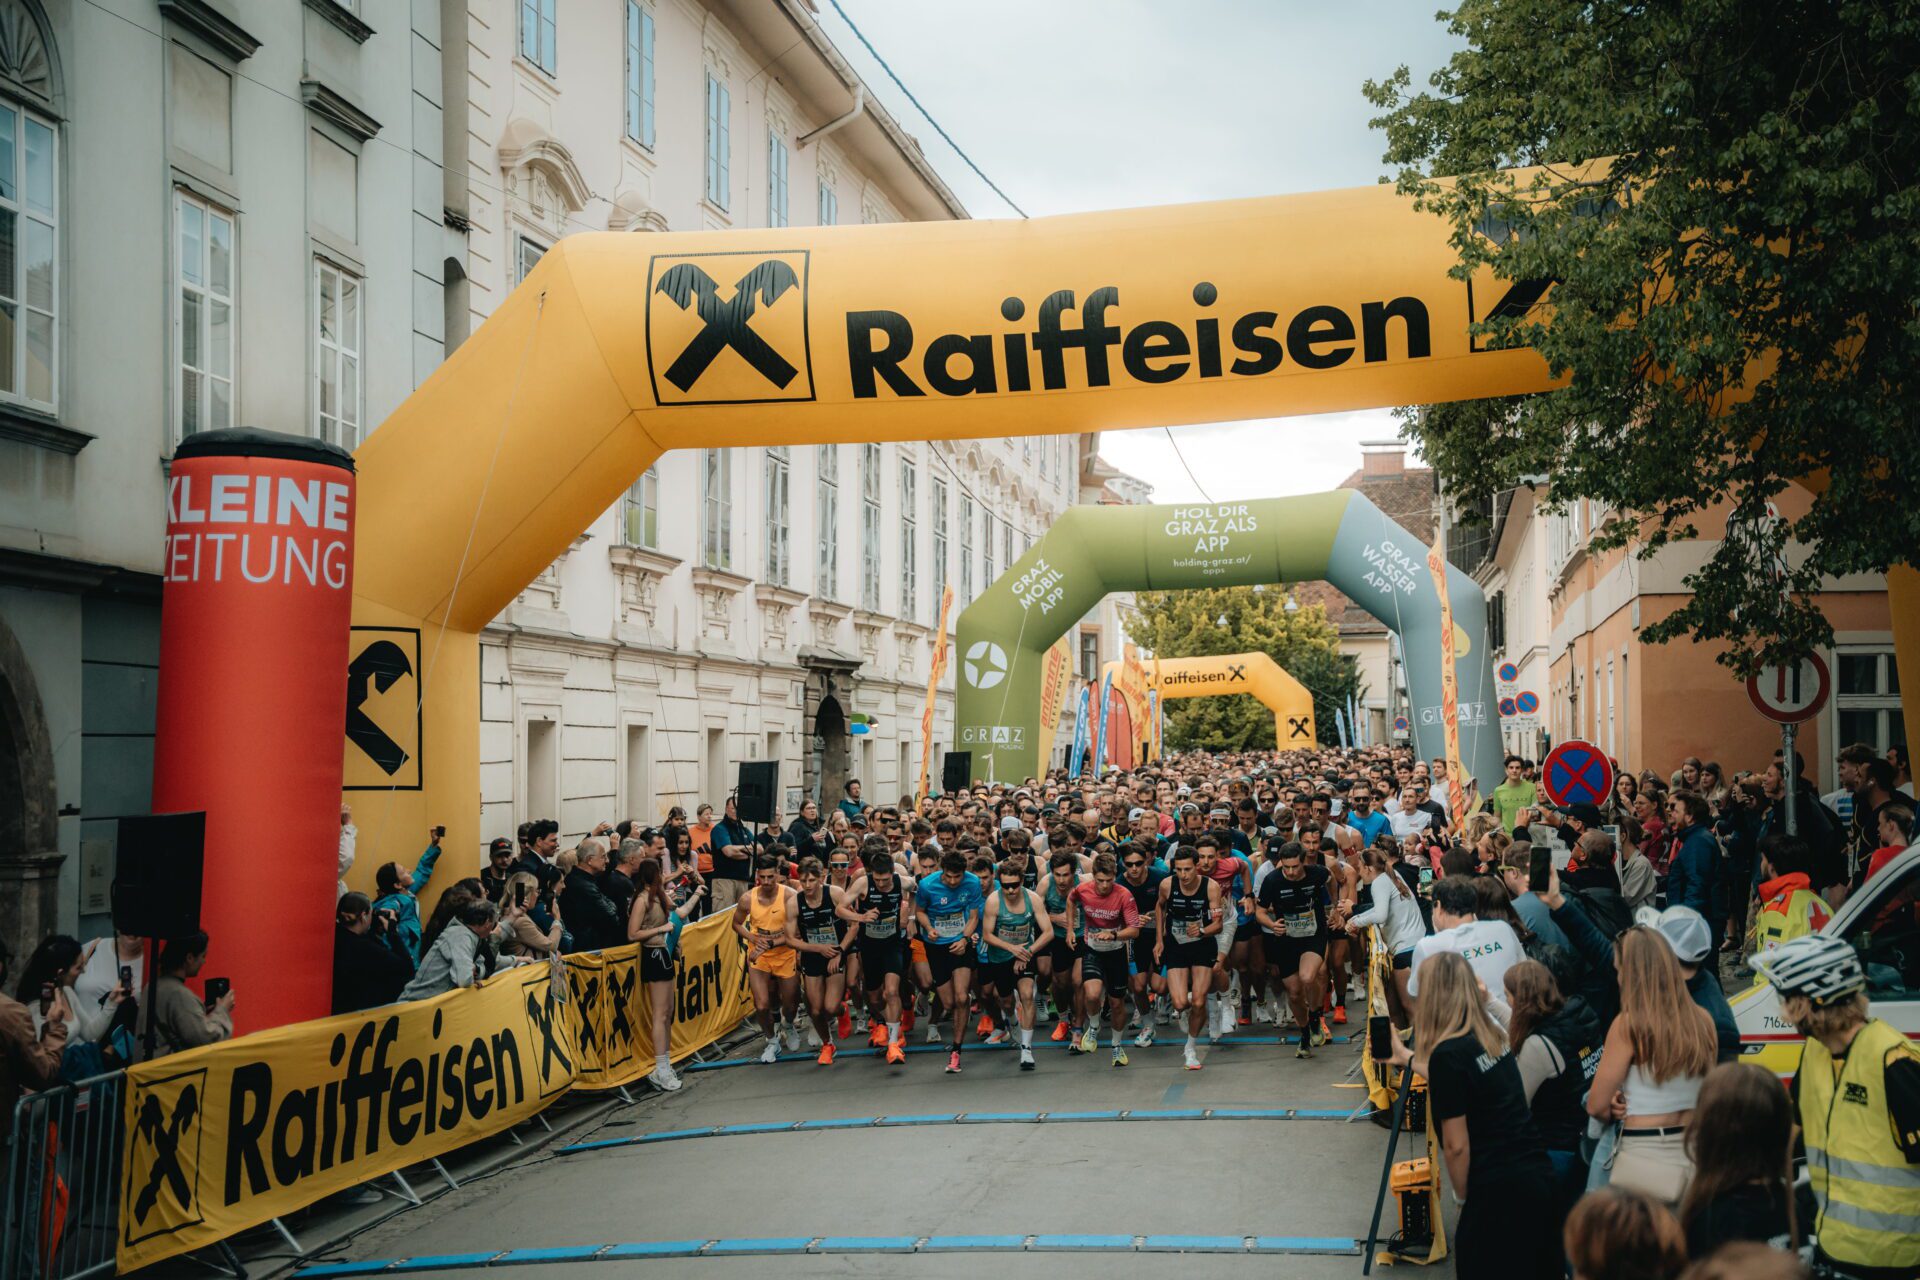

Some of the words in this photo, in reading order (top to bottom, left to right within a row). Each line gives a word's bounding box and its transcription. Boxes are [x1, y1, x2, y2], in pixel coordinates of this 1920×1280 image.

[846, 281, 1431, 398] Raiffeisen
[167, 475, 349, 532] KLEINE
[1174, 508, 1213, 520] HOL
[1218, 505, 1248, 517] DIR
[1165, 519, 1219, 536] GRAZ
[1224, 516, 1257, 533] ALS
[1194, 536, 1229, 553] APP
[1173, 554, 1251, 567] holding-graz.at/
[1362, 544, 1416, 595] WASSER
[1381, 540, 1421, 576] GRAZ
[1011, 559, 1050, 594] GRAZ
[1203, 567, 1225, 575] apps
[1362, 571, 1392, 593] APP
[1019, 569, 1064, 610] MOBIL
[1040, 587, 1064, 615] APP
[1156, 670, 1226, 685] aiffeisen
[1422, 704, 1484, 723] GAZ
[963, 727, 1023, 743] GRAZ
[672, 944, 723, 1025] tart
[224, 1008, 524, 1207] Raiffeisen
